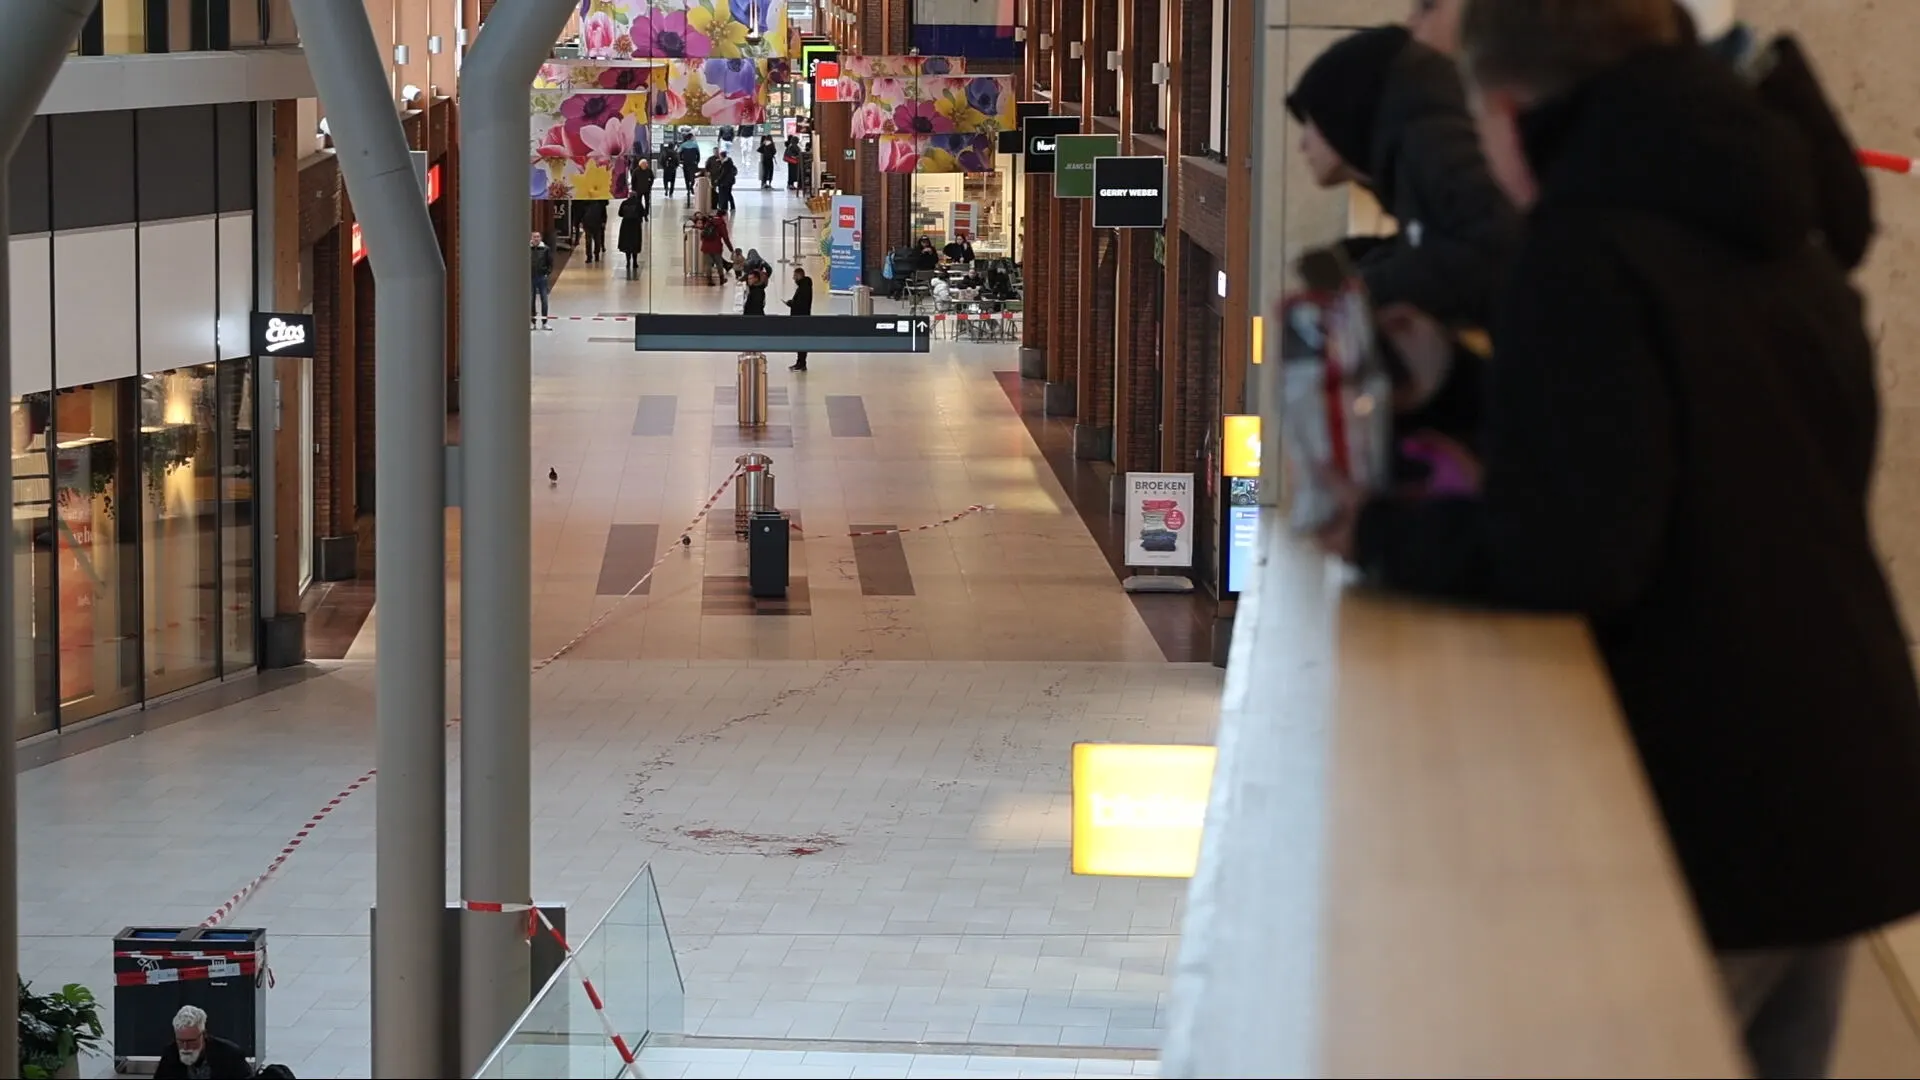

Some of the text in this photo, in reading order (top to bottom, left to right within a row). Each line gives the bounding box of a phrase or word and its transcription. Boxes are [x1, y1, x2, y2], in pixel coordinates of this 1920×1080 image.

[821, 78, 839, 87] HEM
[1100, 189, 1158, 197] GERRY WEBER
[265, 317, 305, 343] Etos
[1135, 481, 1187, 490] BROEKEN
